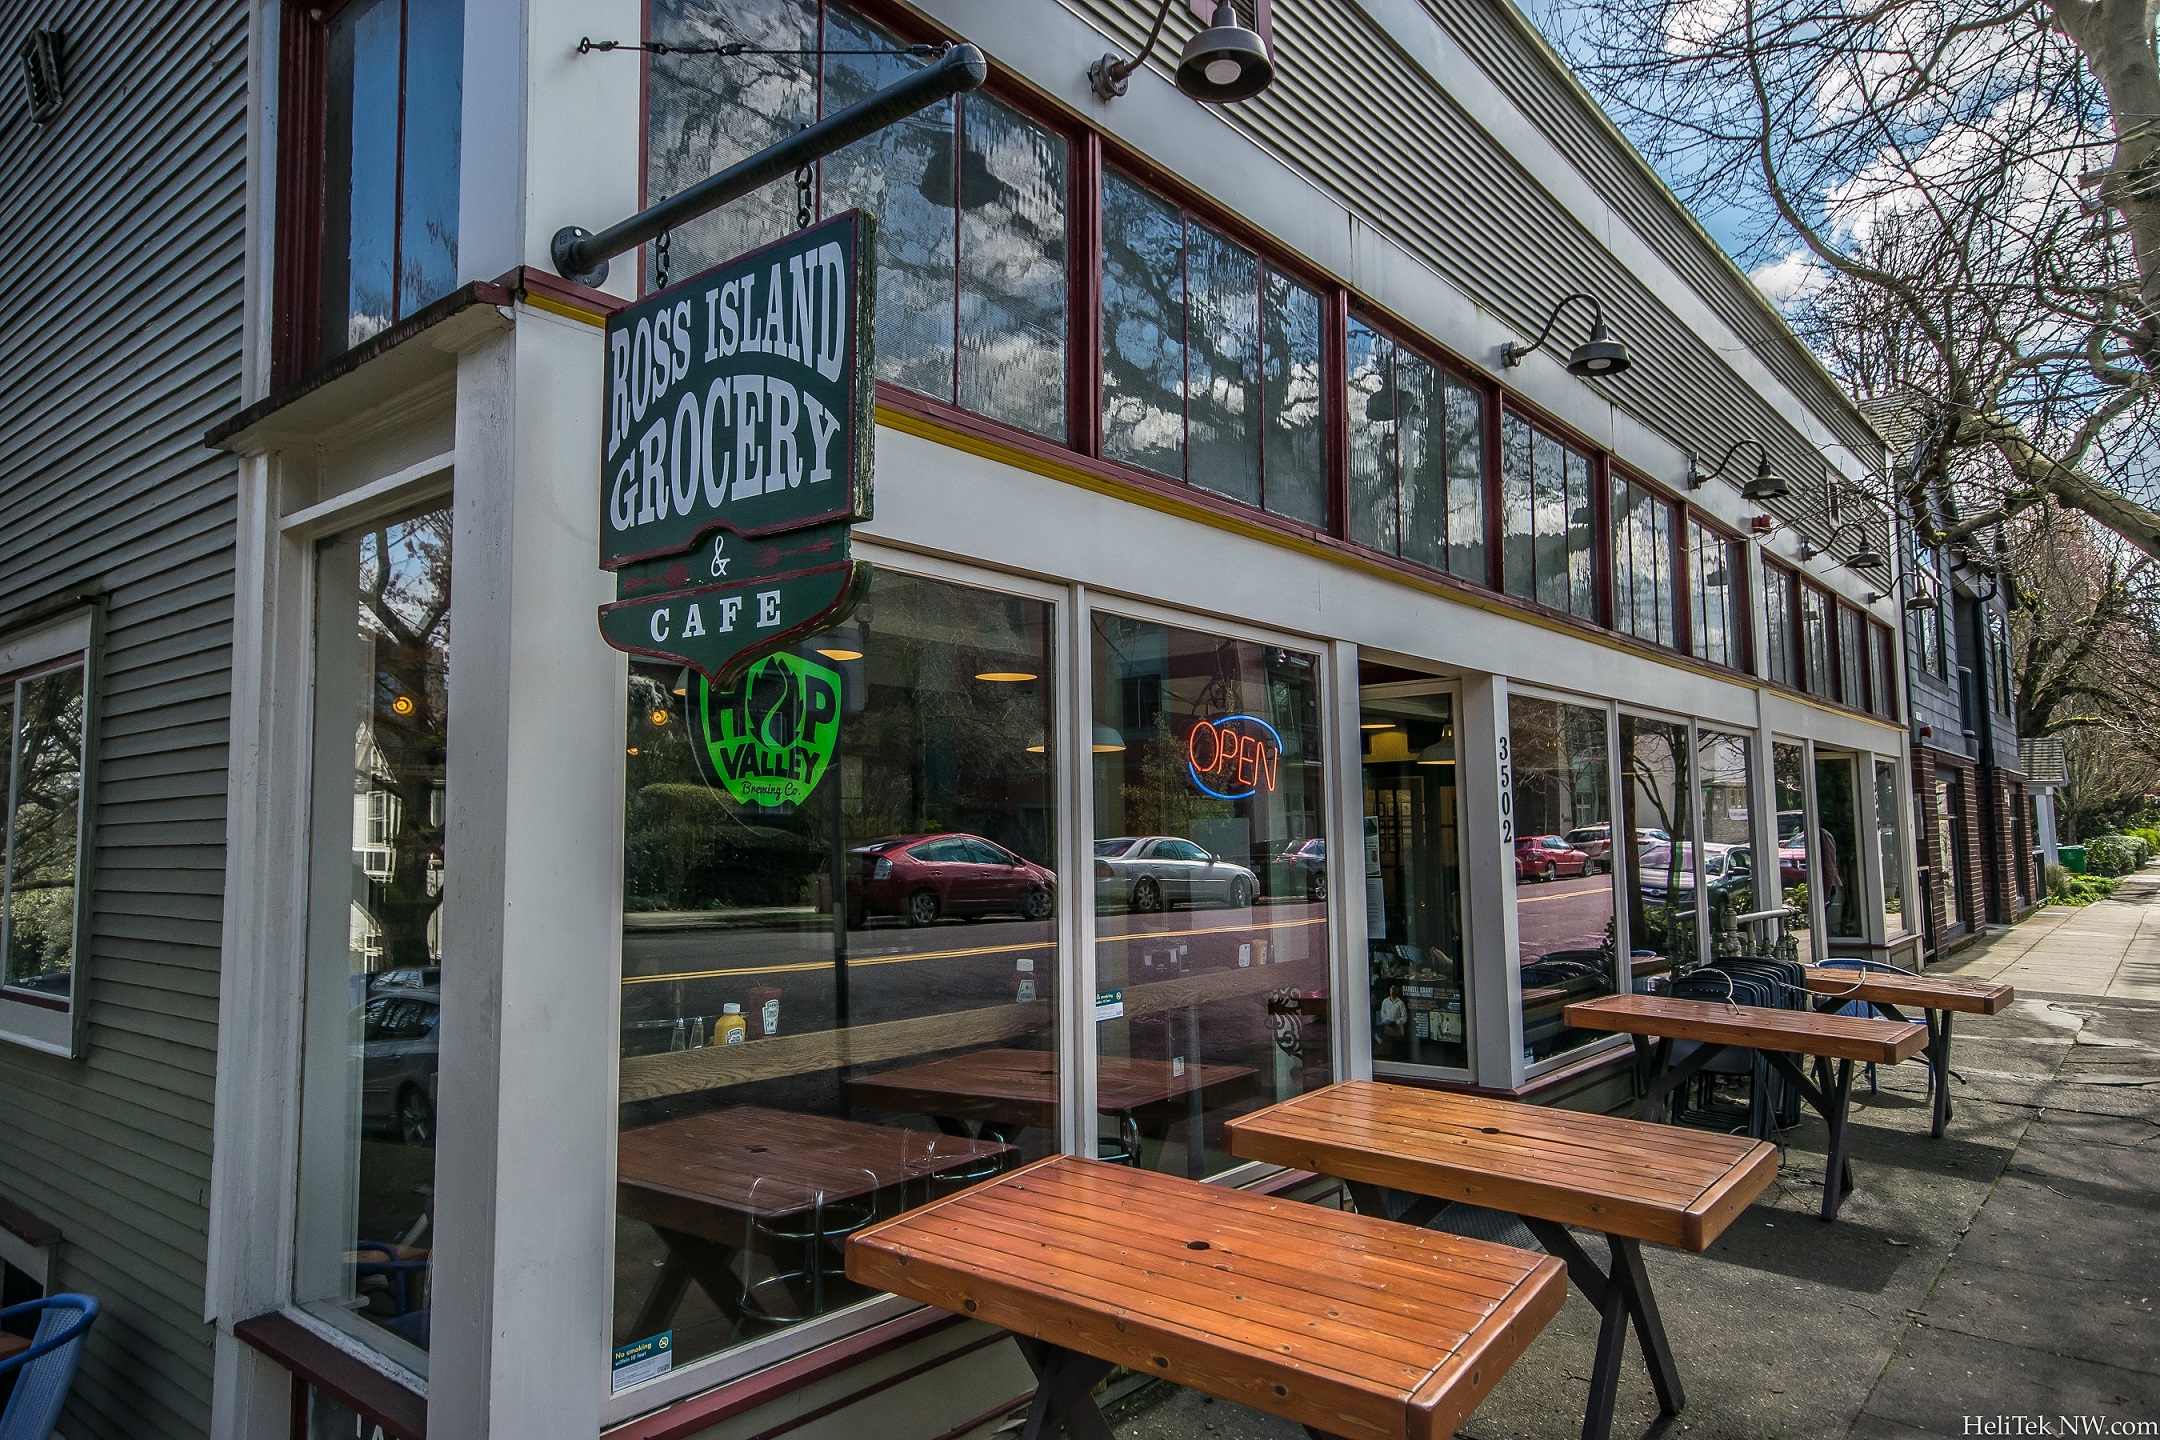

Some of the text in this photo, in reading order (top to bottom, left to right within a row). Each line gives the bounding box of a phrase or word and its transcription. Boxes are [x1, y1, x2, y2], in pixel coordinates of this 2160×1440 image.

[608, 241, 847, 462] ROSS ISLAND
[610, 374, 841, 531] GROCERY
[710, 535, 731, 578] &
[650, 590, 782, 643] CAFE
[719, 742, 821, 784] VALLEY
[1189, 721, 1279, 792] OPEN
[742, 780, 801, 801] Brewing Co.
[1499, 736, 1512, 844] 3502
[626, 1343, 652, 1355] smoking
